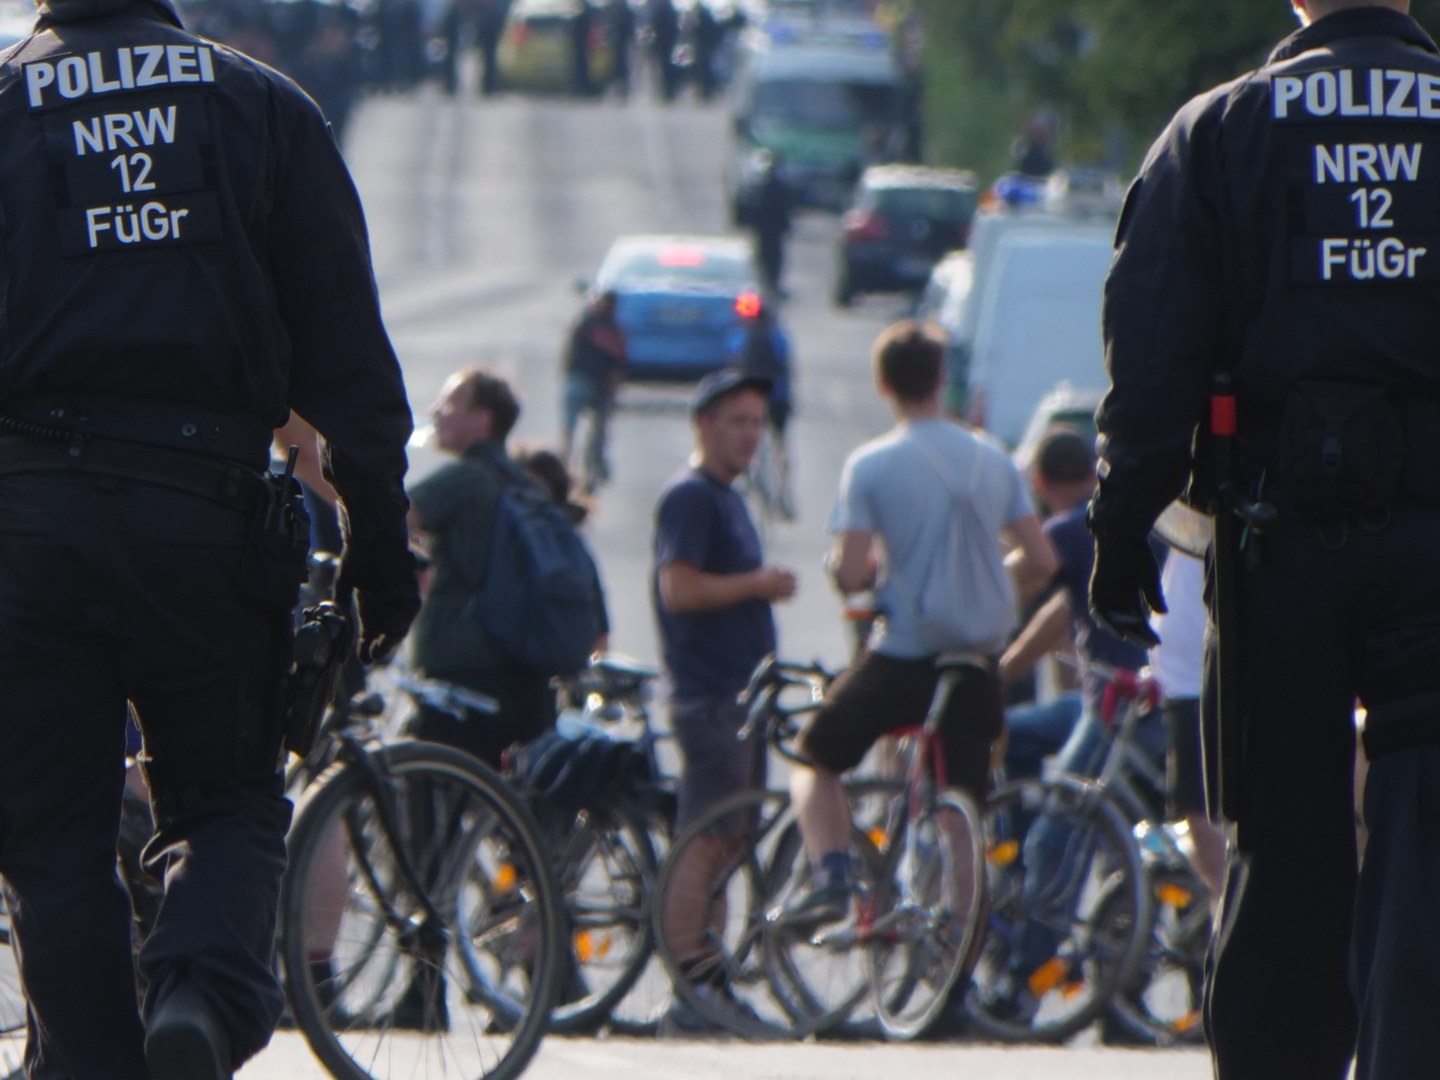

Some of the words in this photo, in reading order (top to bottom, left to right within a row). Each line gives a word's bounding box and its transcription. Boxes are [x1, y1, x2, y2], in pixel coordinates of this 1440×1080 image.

[25, 44, 215, 107] POLIZEI
[1273, 68, 1440, 118] POLIZE
[72, 105, 177, 156] NRW
[110, 152, 156, 193] 12
[1314, 143, 1422, 184] NRW
[86, 201, 190, 248] FüGr
[1350, 187, 1394, 228] 12
[1322, 237, 1427, 280] FüGr
